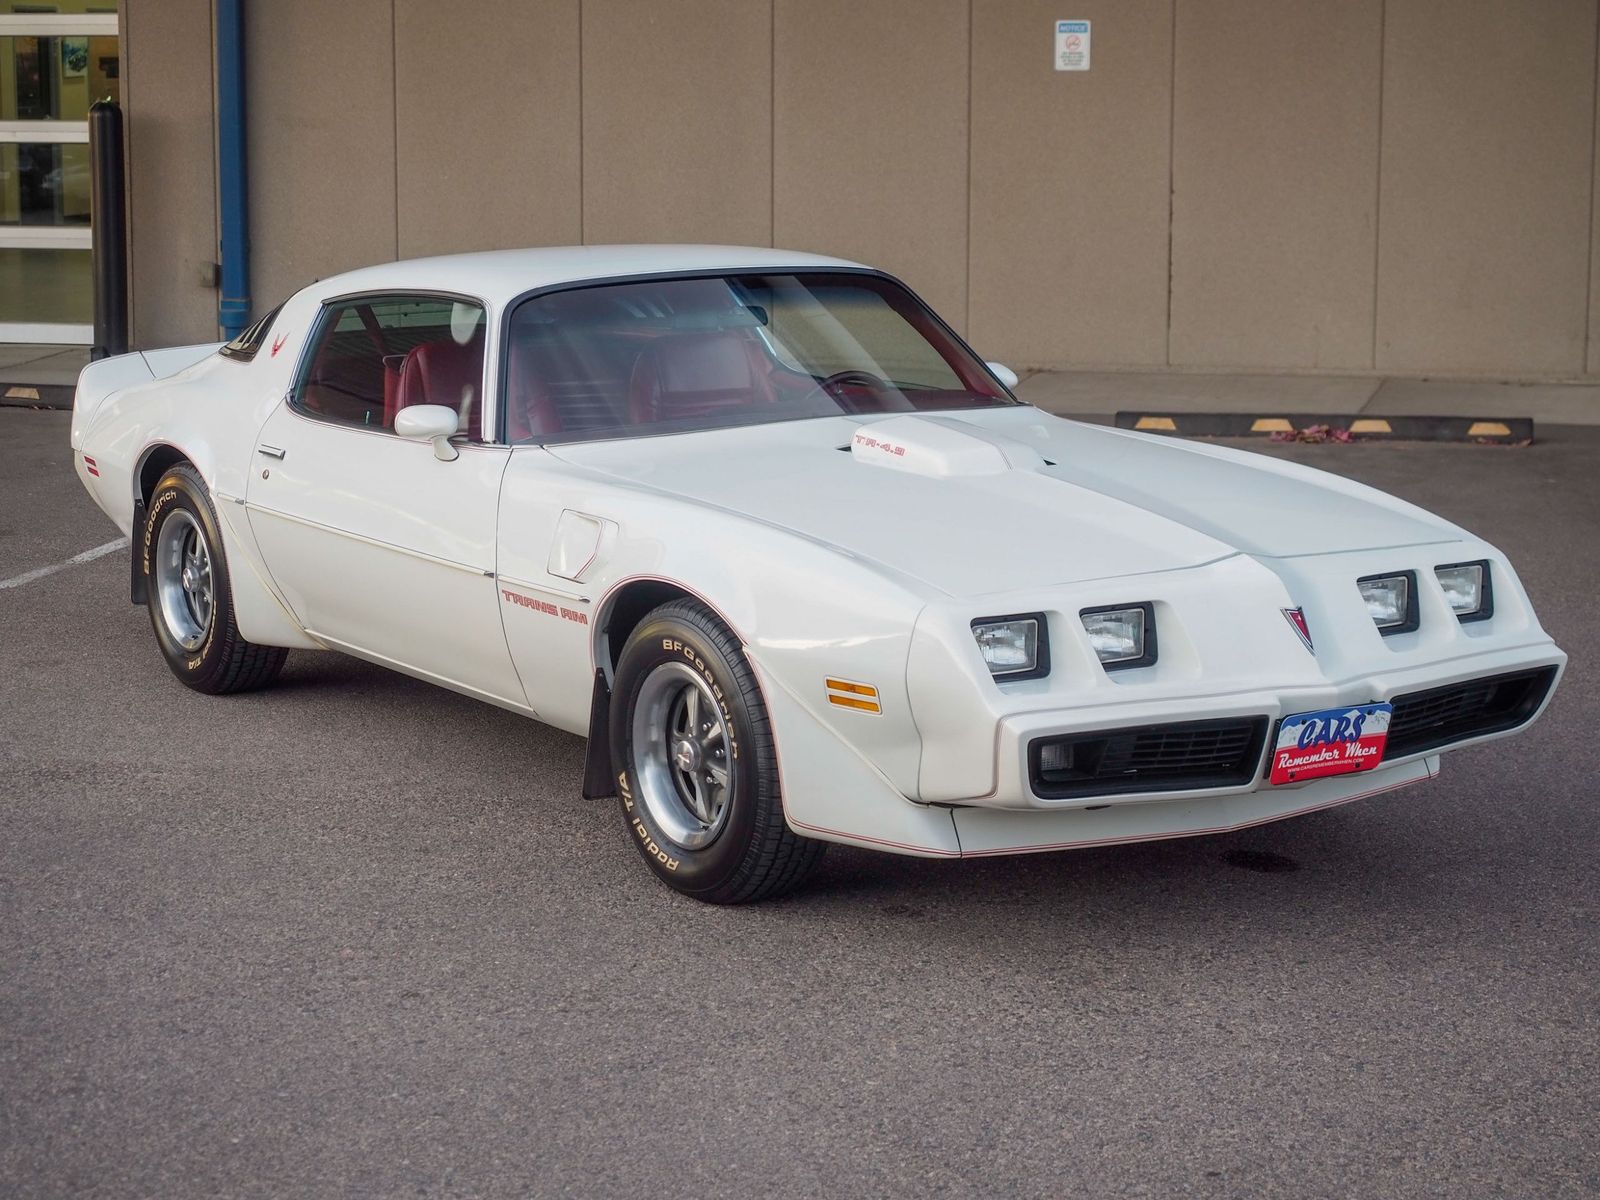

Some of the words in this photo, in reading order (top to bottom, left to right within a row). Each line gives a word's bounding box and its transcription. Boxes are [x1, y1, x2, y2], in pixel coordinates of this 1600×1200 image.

[143, 490, 177, 575] BFGoodrich
[501, 589, 559, 616] TRANS
[560, 607, 588, 625] AM
[662, 639, 738, 759] BFGoodrich
[1297, 713, 1367, 750] CARS
[1278, 747, 1340, 769] Remember
[1345, 742, 1377, 757] When
[618, 771, 634, 812] T/A
[632, 817, 679, 871] Radial
